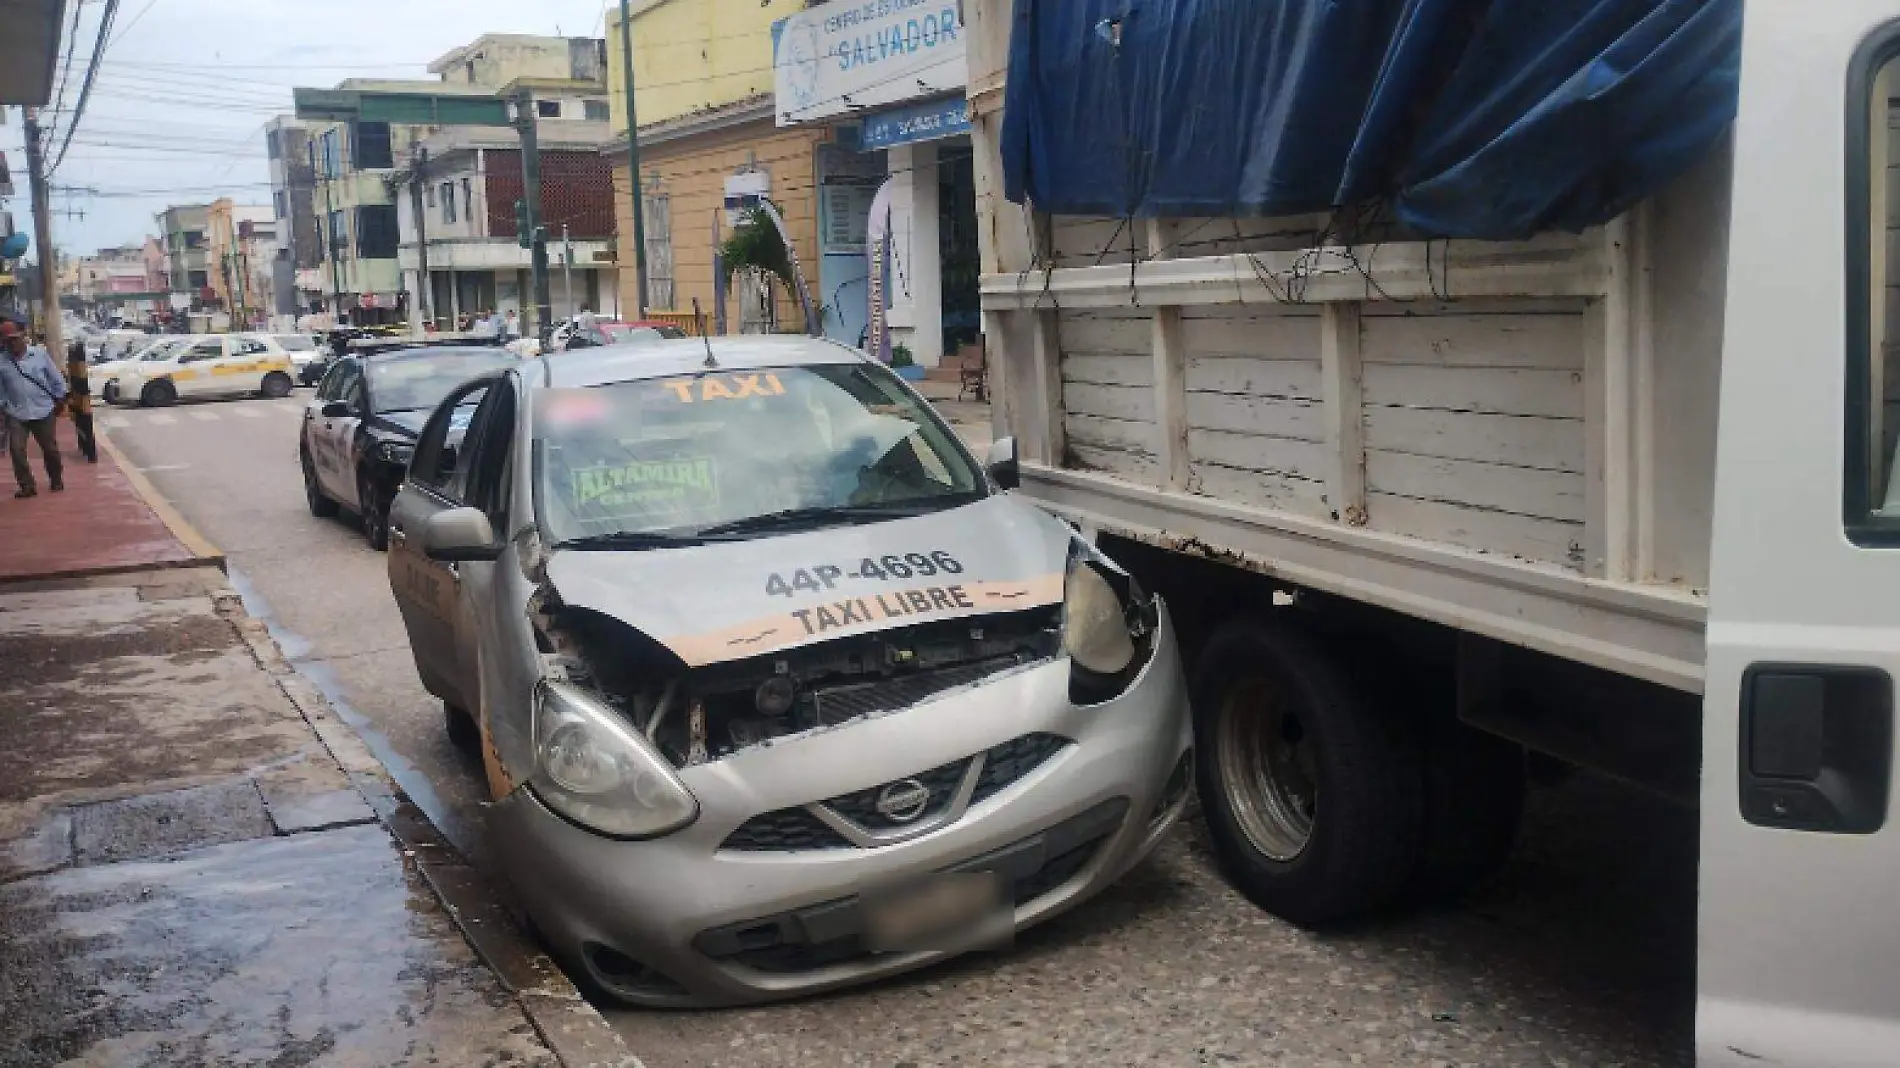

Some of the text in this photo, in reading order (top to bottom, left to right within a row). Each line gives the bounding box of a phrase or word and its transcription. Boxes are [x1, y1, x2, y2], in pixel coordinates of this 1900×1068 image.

[664, 372, 788, 403] TAXI
[579, 460, 709, 503] ALTAMIRA
[792, 585, 974, 635] TAXI LIBRE
